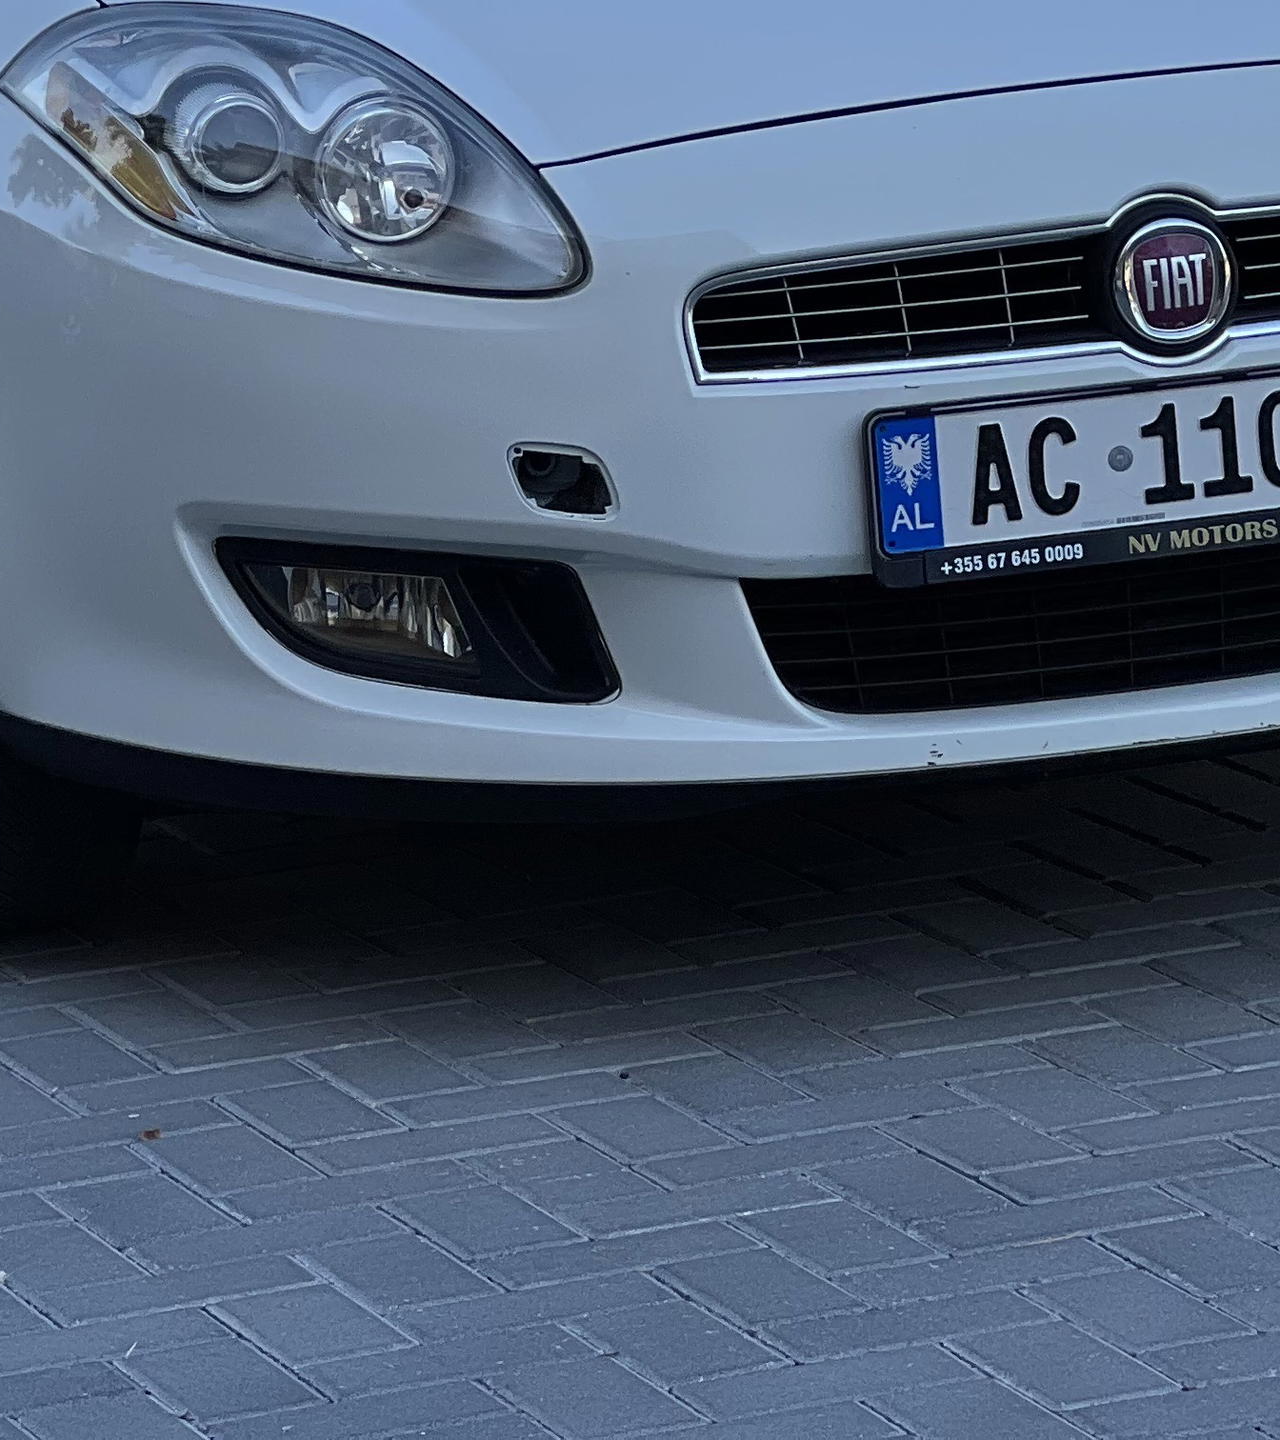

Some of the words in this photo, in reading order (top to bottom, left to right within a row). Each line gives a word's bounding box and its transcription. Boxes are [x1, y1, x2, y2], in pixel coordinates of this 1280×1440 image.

[1141, 252, 1207, 312] FIAT
[971, 417, 1081, 526] AC
[891, 502, 935, 533] AL
[1127, 532, 1162, 555] NV
[1169, 518, 1279, 551] MOTORS
[940, 554, 983, 576] +355
[987, 551, 1006, 570] 67
[1011, 548, 1041, 567] 645
[1045, 543, 1084, 563] 0009
